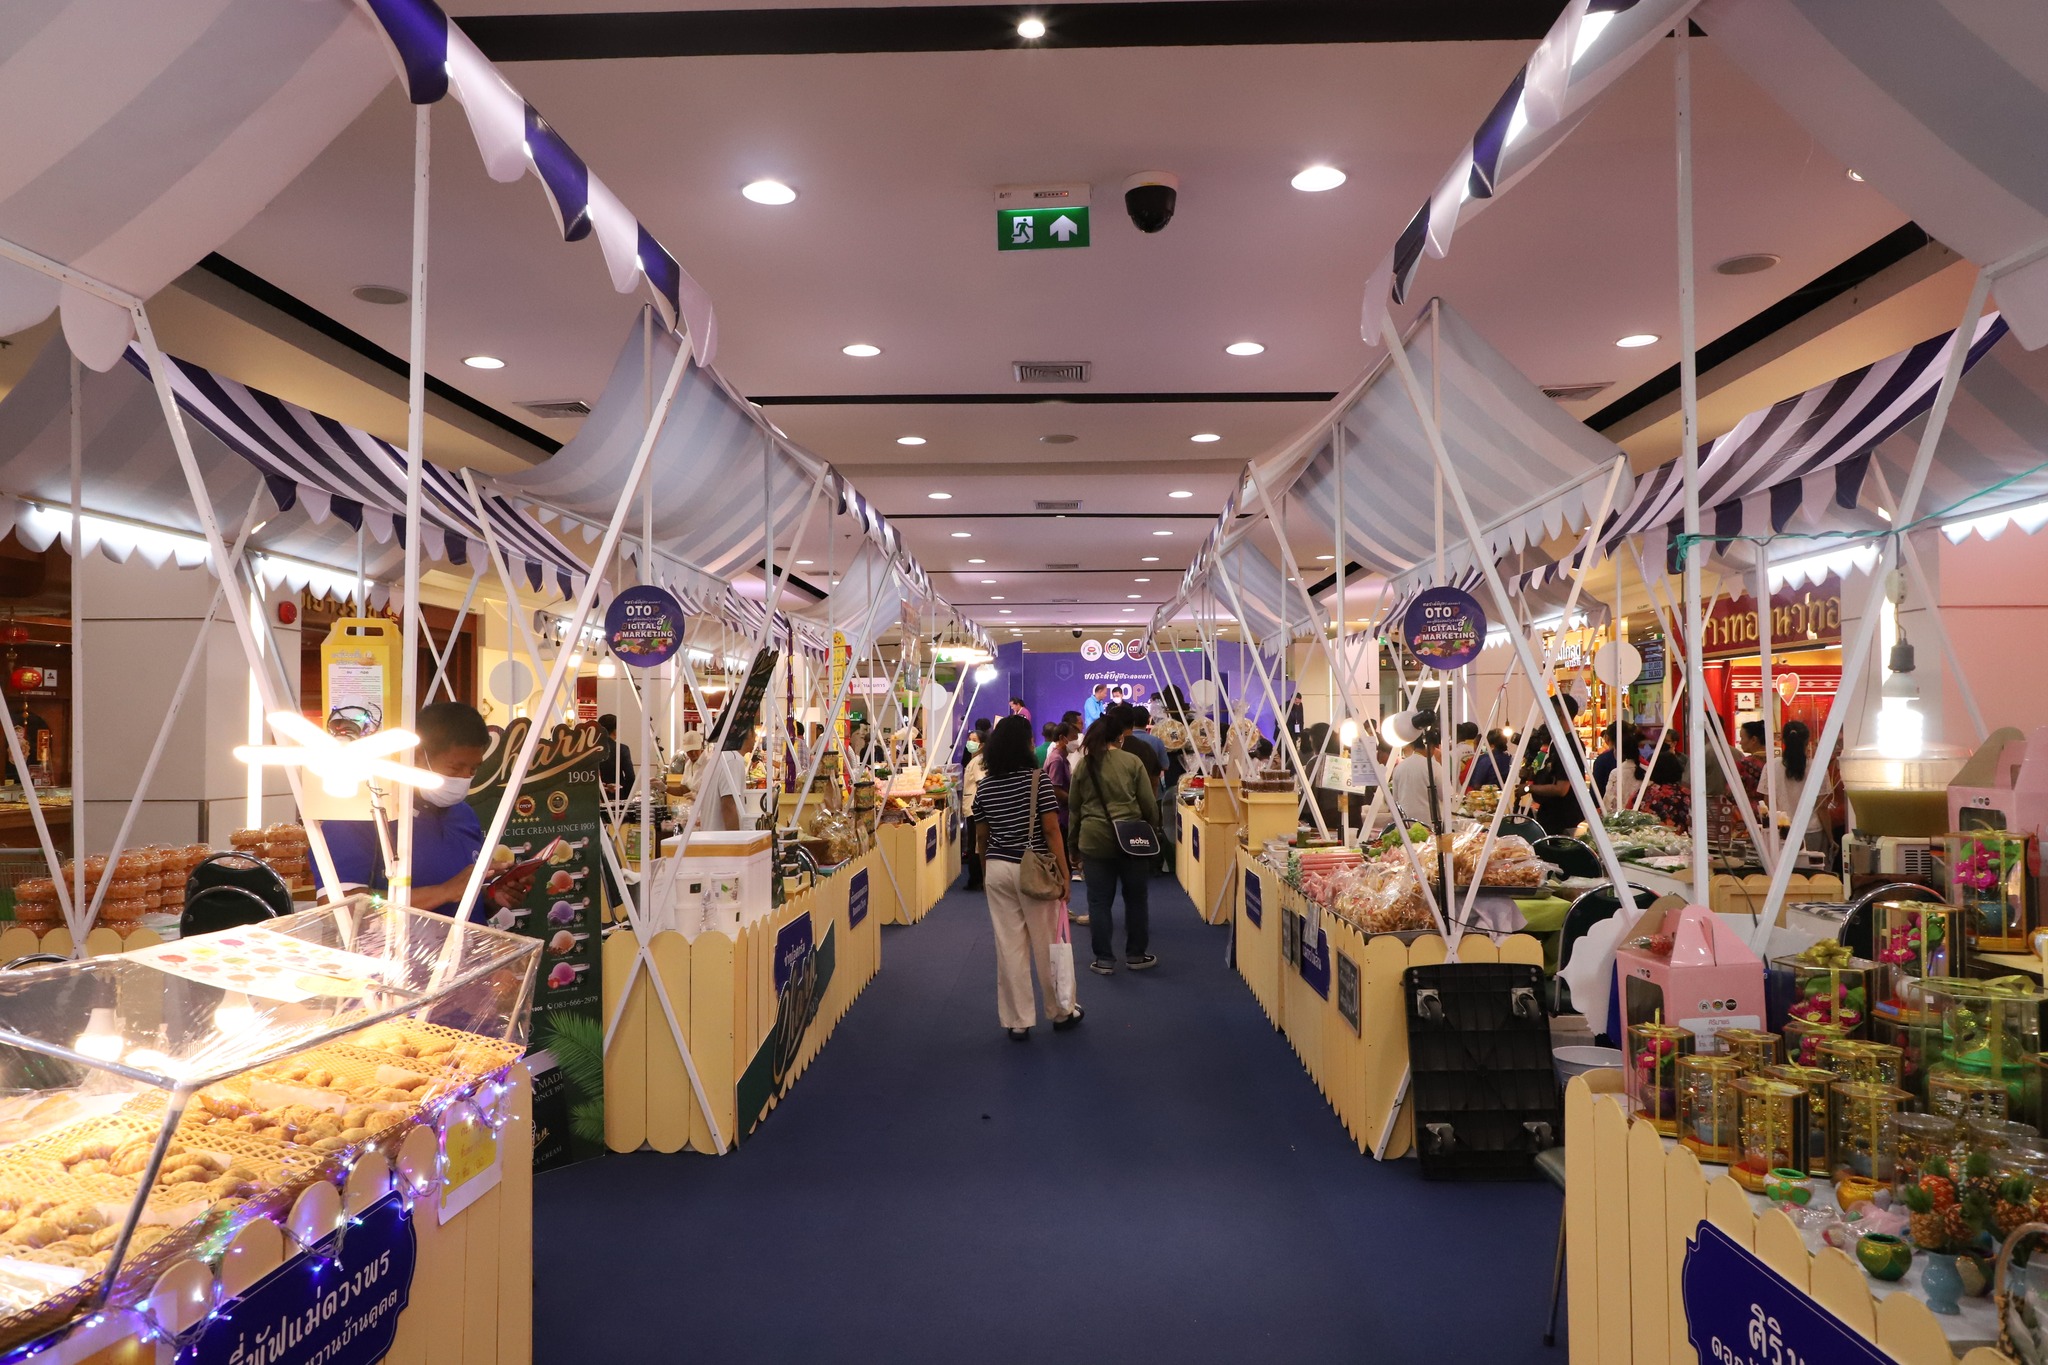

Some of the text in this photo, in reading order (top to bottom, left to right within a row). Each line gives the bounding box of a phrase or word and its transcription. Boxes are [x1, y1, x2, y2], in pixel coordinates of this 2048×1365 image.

[626, 605, 660, 616] OTOP
[1425, 607, 1460, 618] OTOP
[1422, 632, 1475, 640] MARKETING
[567, 770, 596, 783] 1905
[512, 828, 525, 836] ICE
[527, 826, 555, 835] CREAM
[557, 823, 579, 832] SINCE
[580, 822, 595, 830] 1905
[538, 1071, 563, 1091] MAD
